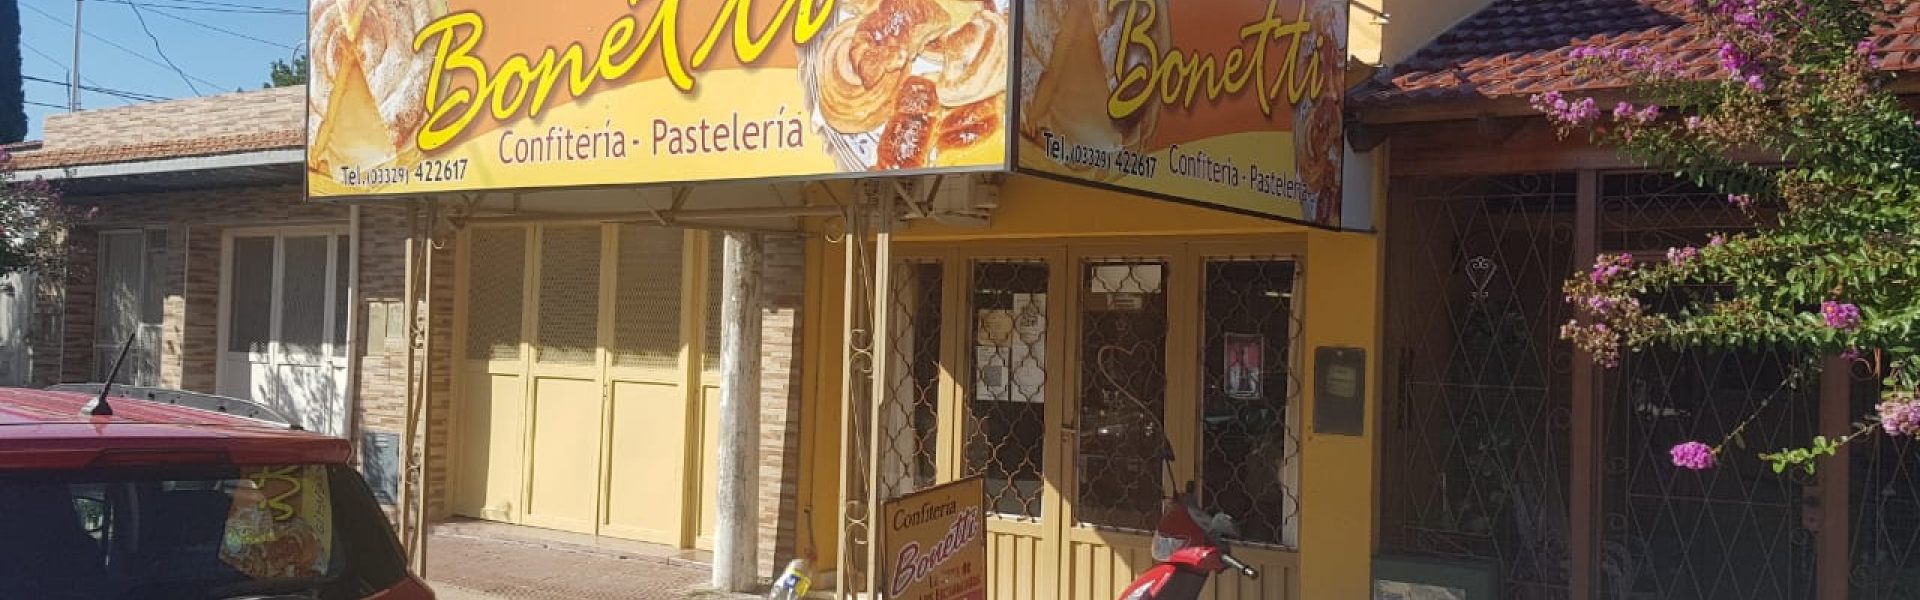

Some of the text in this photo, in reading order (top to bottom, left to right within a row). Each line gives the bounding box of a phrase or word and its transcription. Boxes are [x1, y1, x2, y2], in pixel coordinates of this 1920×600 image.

[1107, 0, 1325, 119] Bonetti
[499, 119, 626, 164] Confitería
[652, 106, 804, 156] Pastelería
[1115, 150, 1157, 178] 422617
[415, 159, 468, 182] 422617
[890, 507, 978, 597] Bonetti
